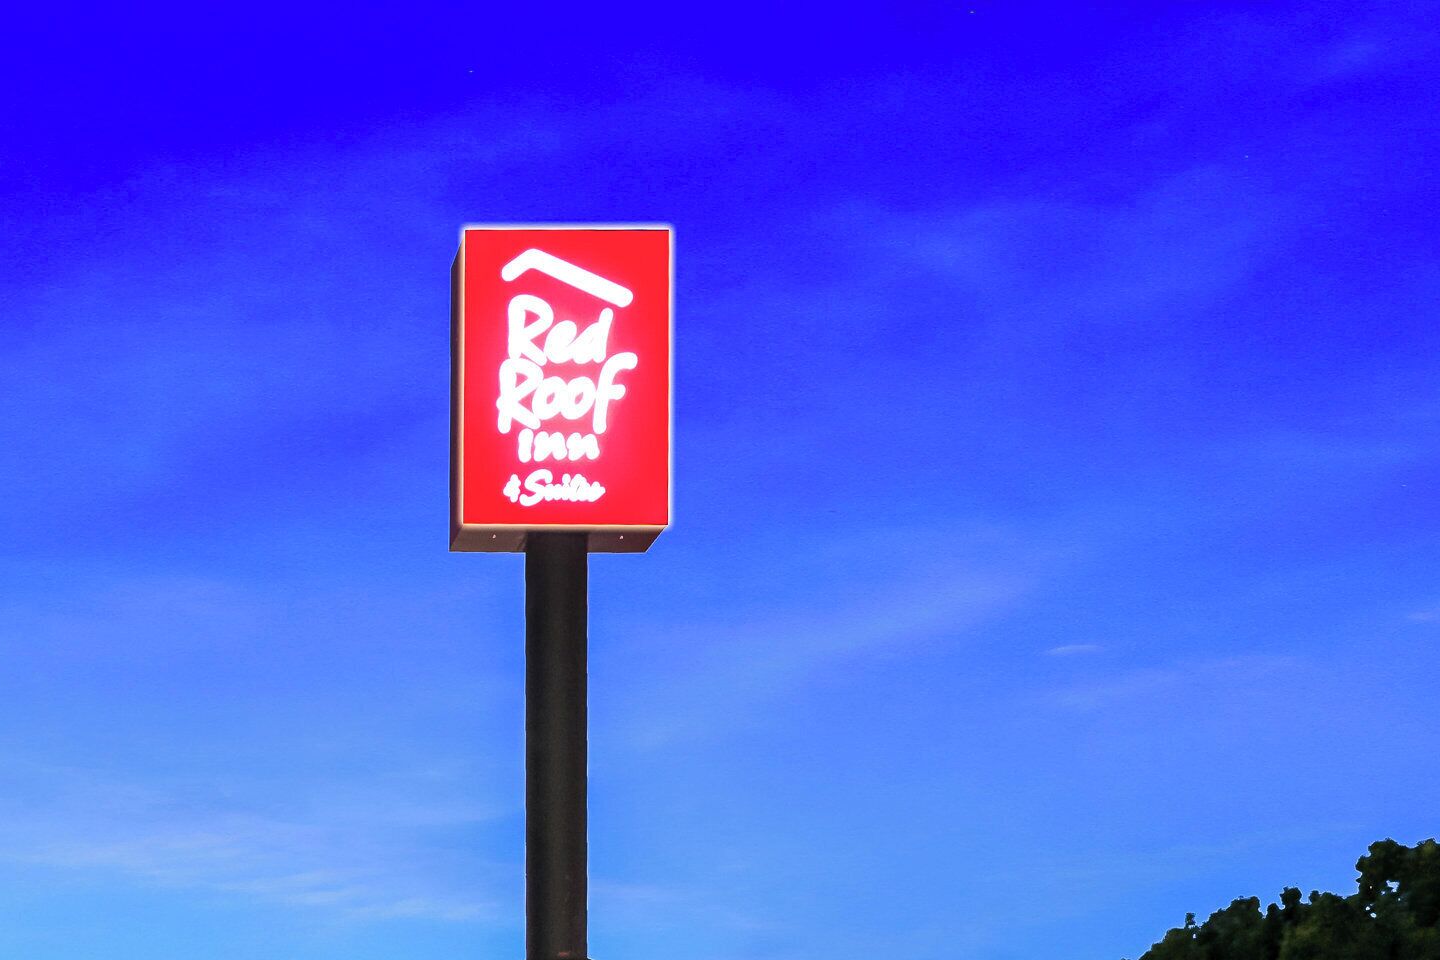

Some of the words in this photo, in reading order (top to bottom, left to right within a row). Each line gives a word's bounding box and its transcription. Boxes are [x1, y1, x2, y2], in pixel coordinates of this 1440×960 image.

[507, 294, 614, 367] Red
[496, 352, 638, 434] Roof
[518, 428, 601, 463] Inn
